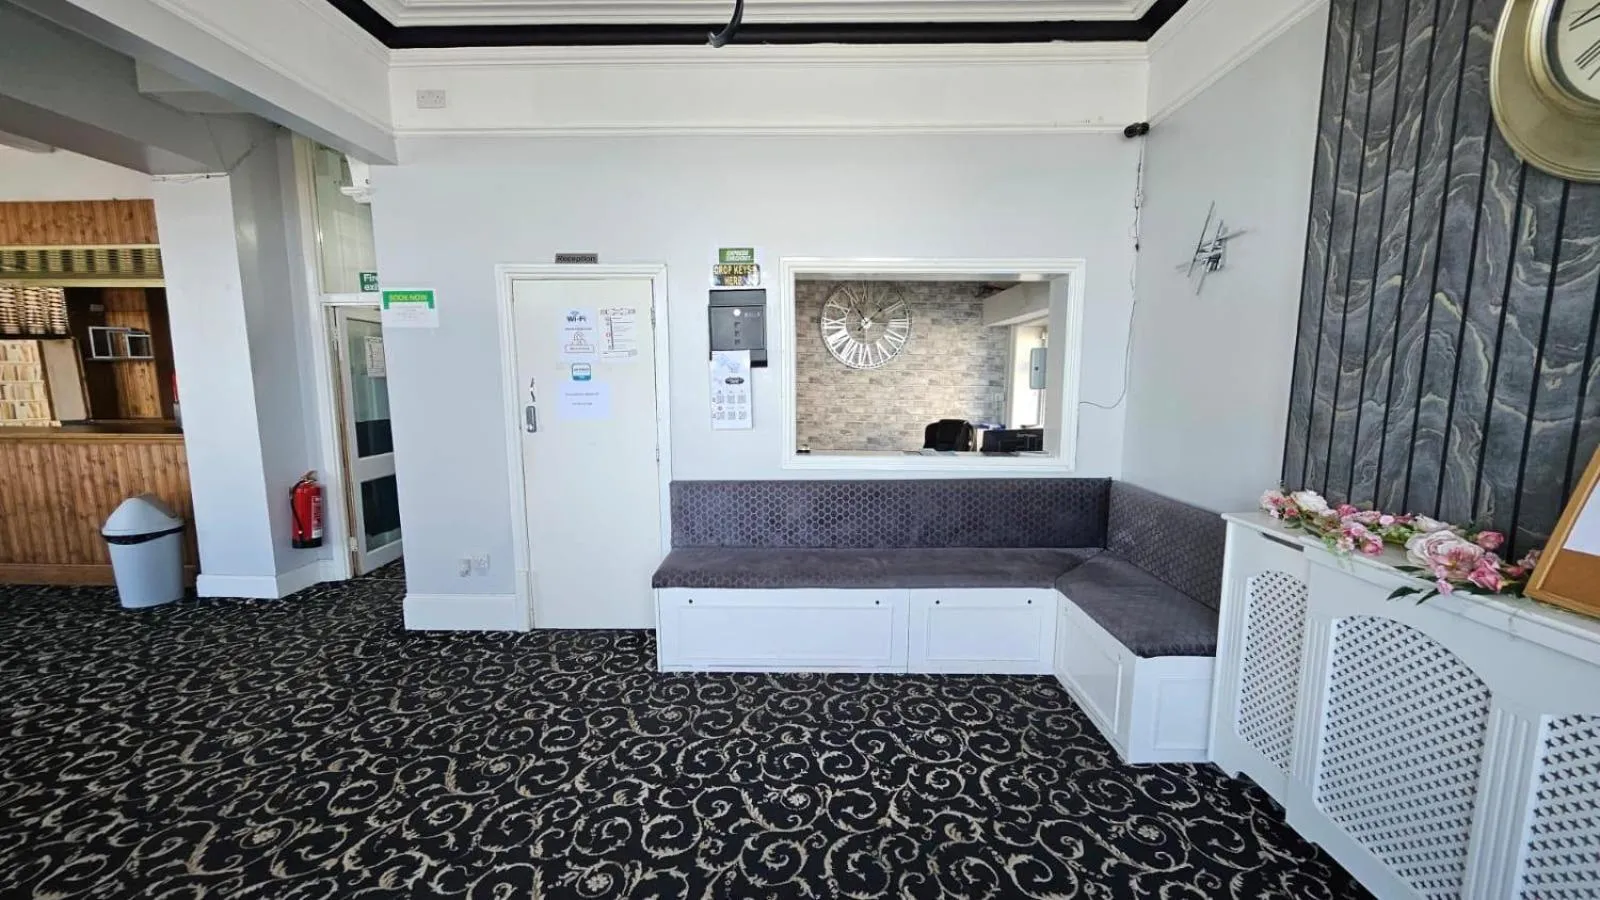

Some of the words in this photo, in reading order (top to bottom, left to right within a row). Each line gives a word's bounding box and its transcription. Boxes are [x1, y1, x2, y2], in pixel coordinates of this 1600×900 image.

[557, 255, 596, 263] Reception
[713, 264, 732, 274] DROP
[733, 264, 752, 274] KEYS
[363, 273, 377, 282] Fir
[723, 276, 743, 286] HERE
